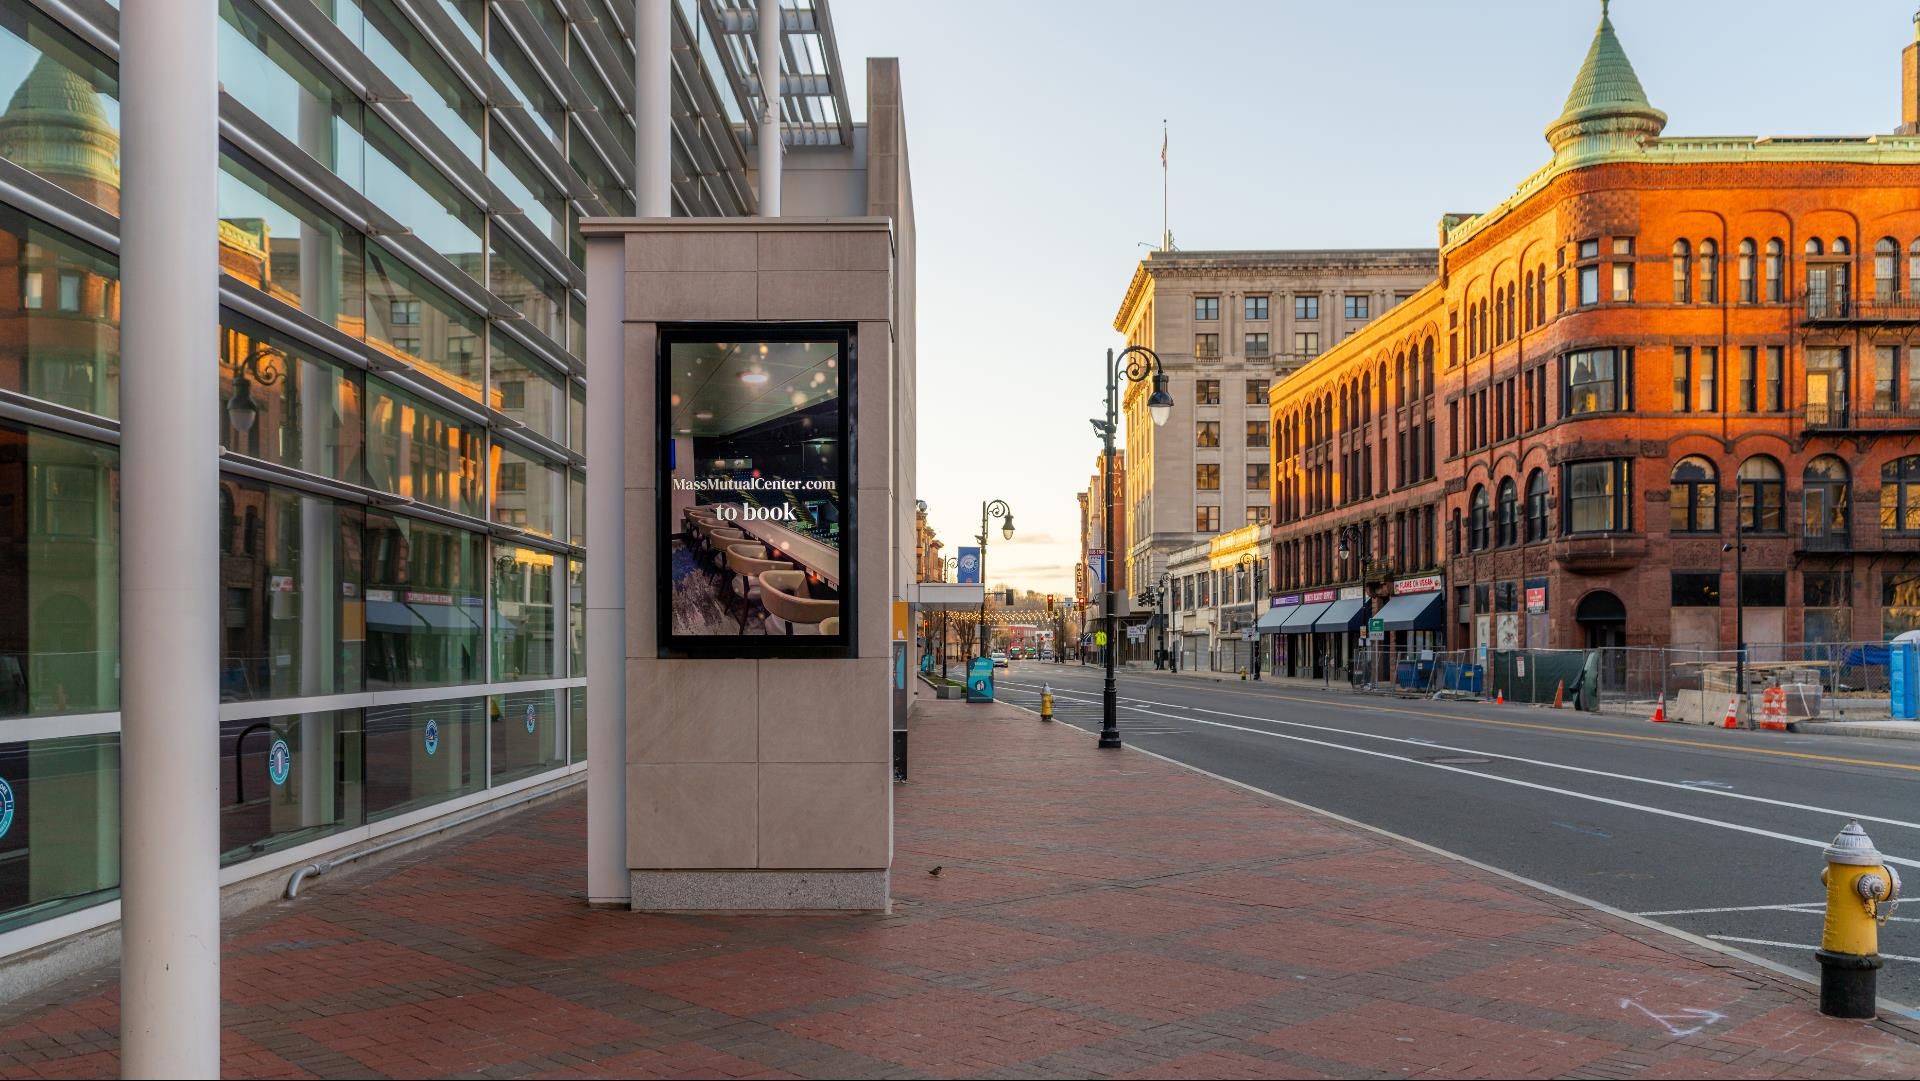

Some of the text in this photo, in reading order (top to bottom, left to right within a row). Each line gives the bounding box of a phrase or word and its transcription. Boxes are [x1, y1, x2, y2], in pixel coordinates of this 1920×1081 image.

[673, 477, 836, 491] MassMutualCenter.com
[716, 502, 797, 521] to book
